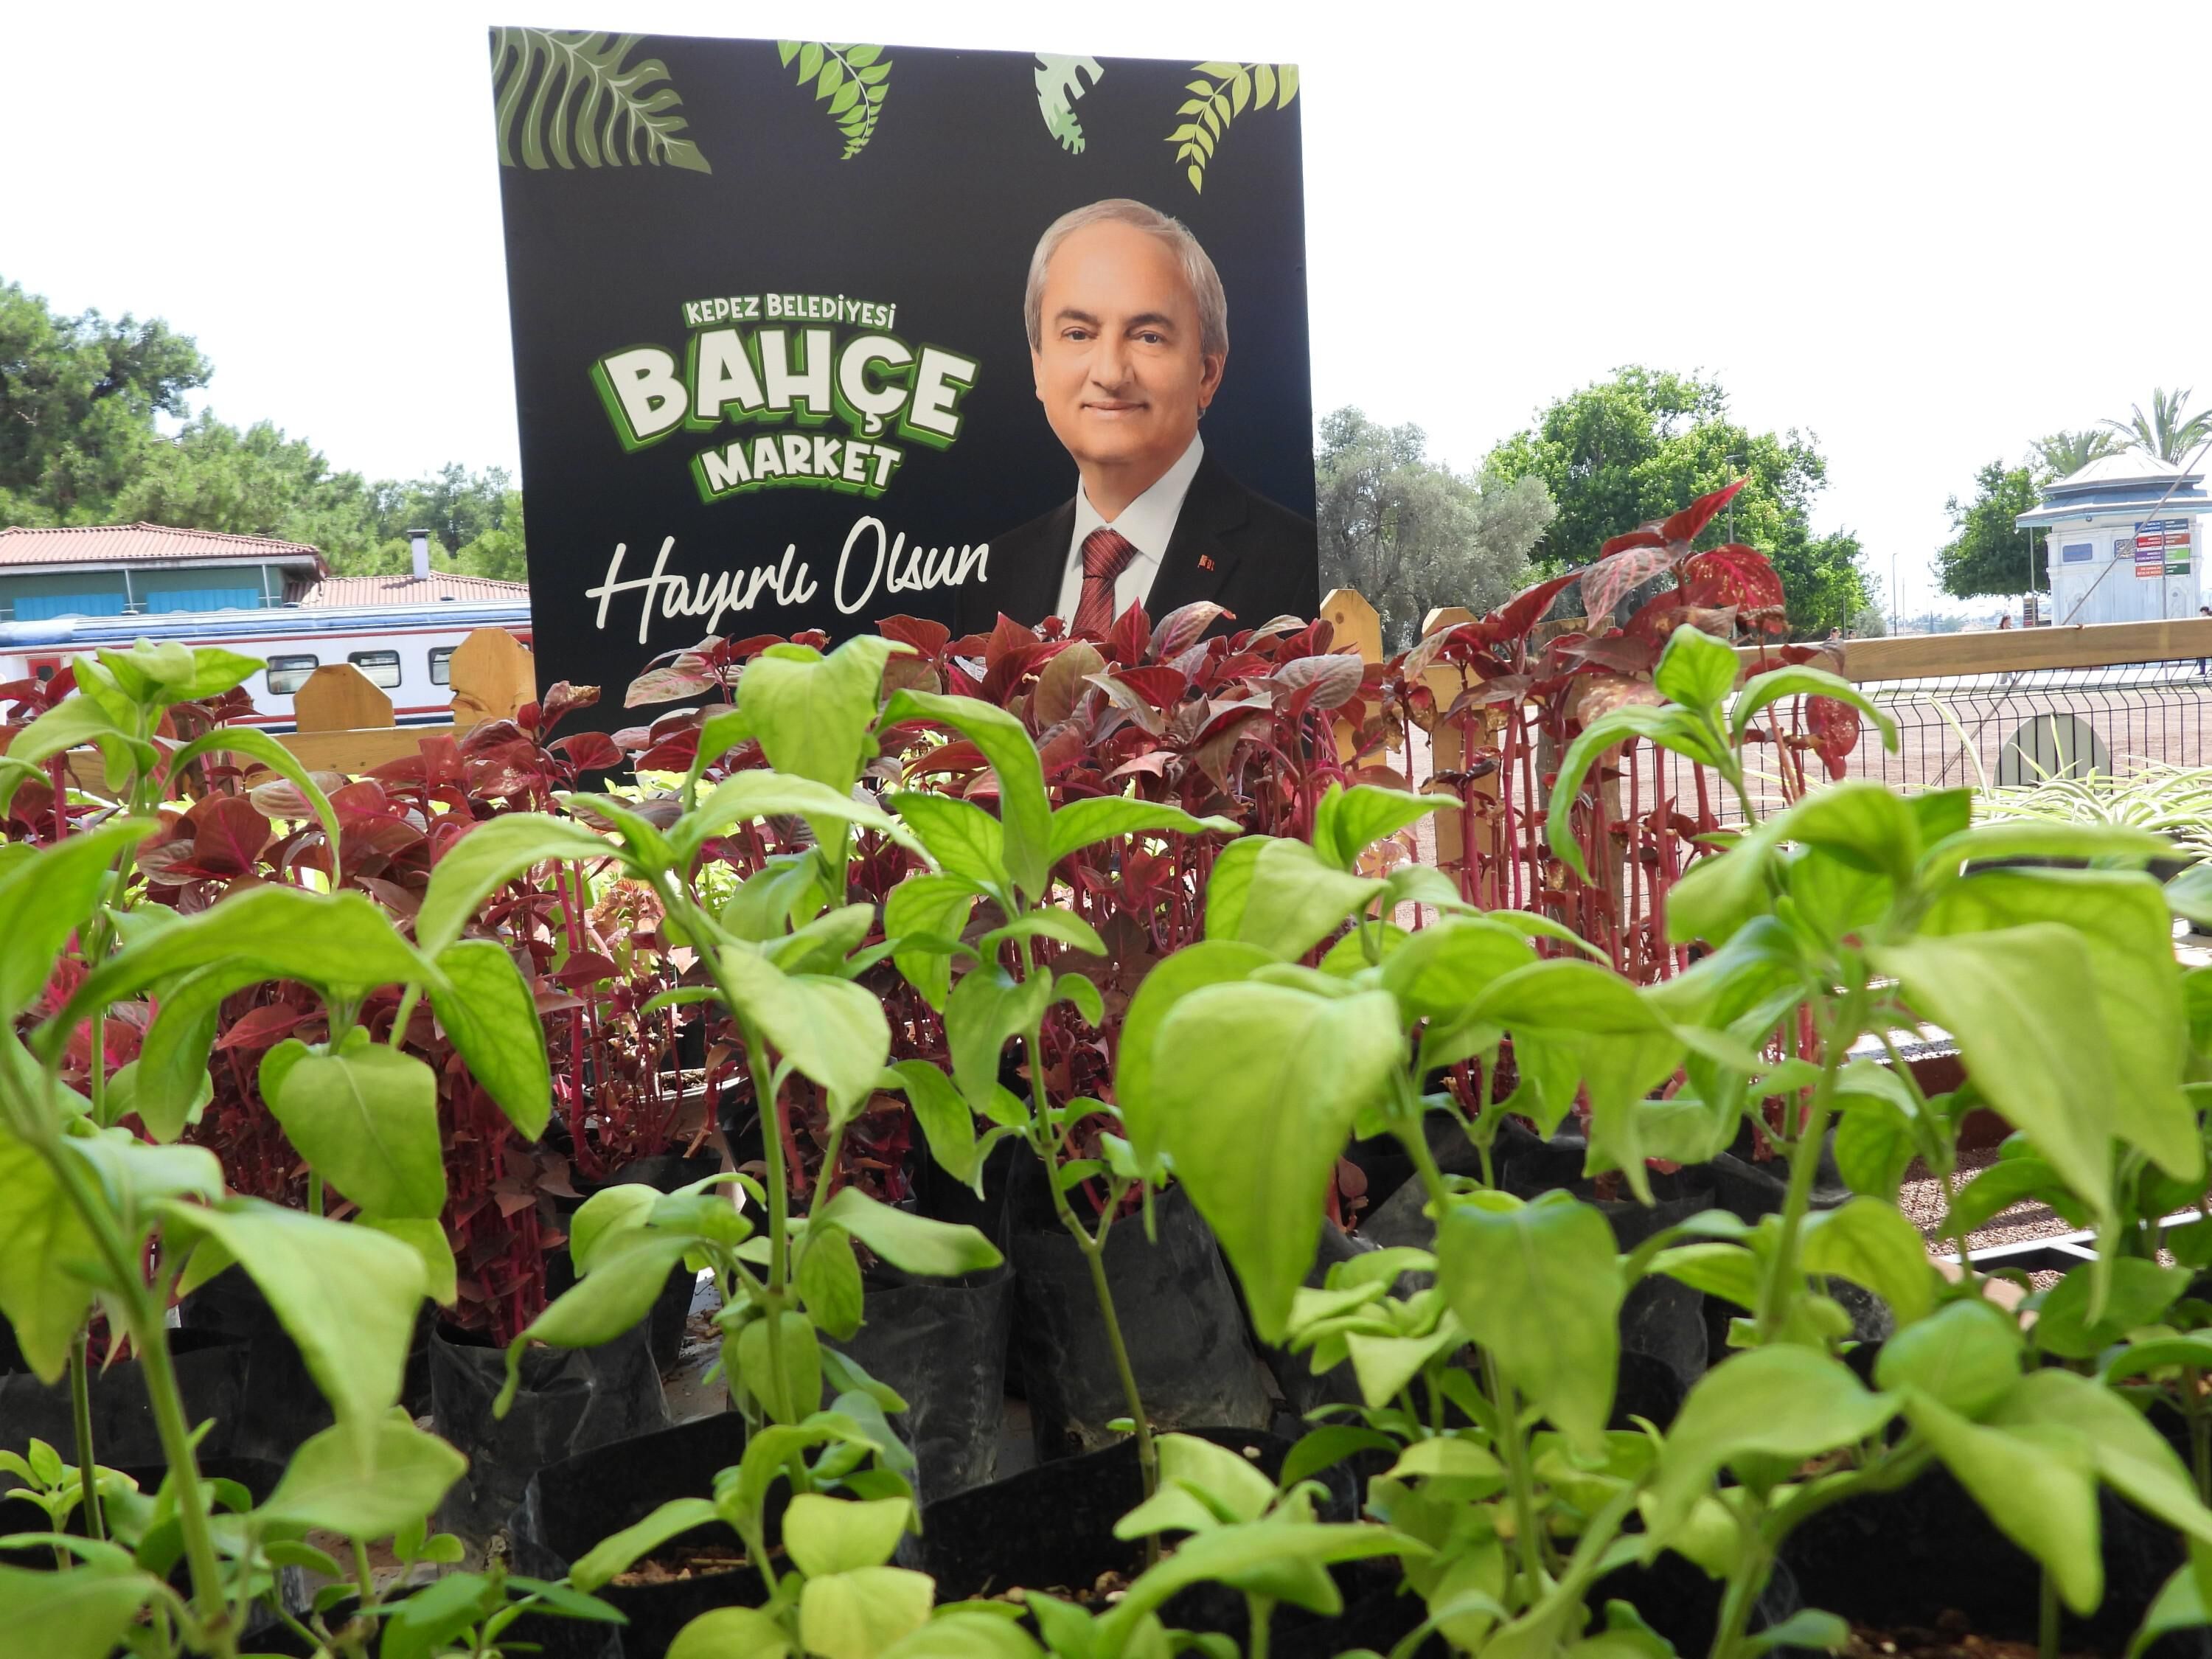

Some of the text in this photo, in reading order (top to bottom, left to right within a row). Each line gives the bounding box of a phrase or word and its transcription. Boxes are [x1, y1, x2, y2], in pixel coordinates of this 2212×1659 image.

[685, 293, 897, 330] KEPEZ BELEDİYESİ
[602, 327, 977, 438] BAHÇE
[700, 434, 901, 491] MARKET
[585, 515, 989, 644] Hayırlı Olsun
